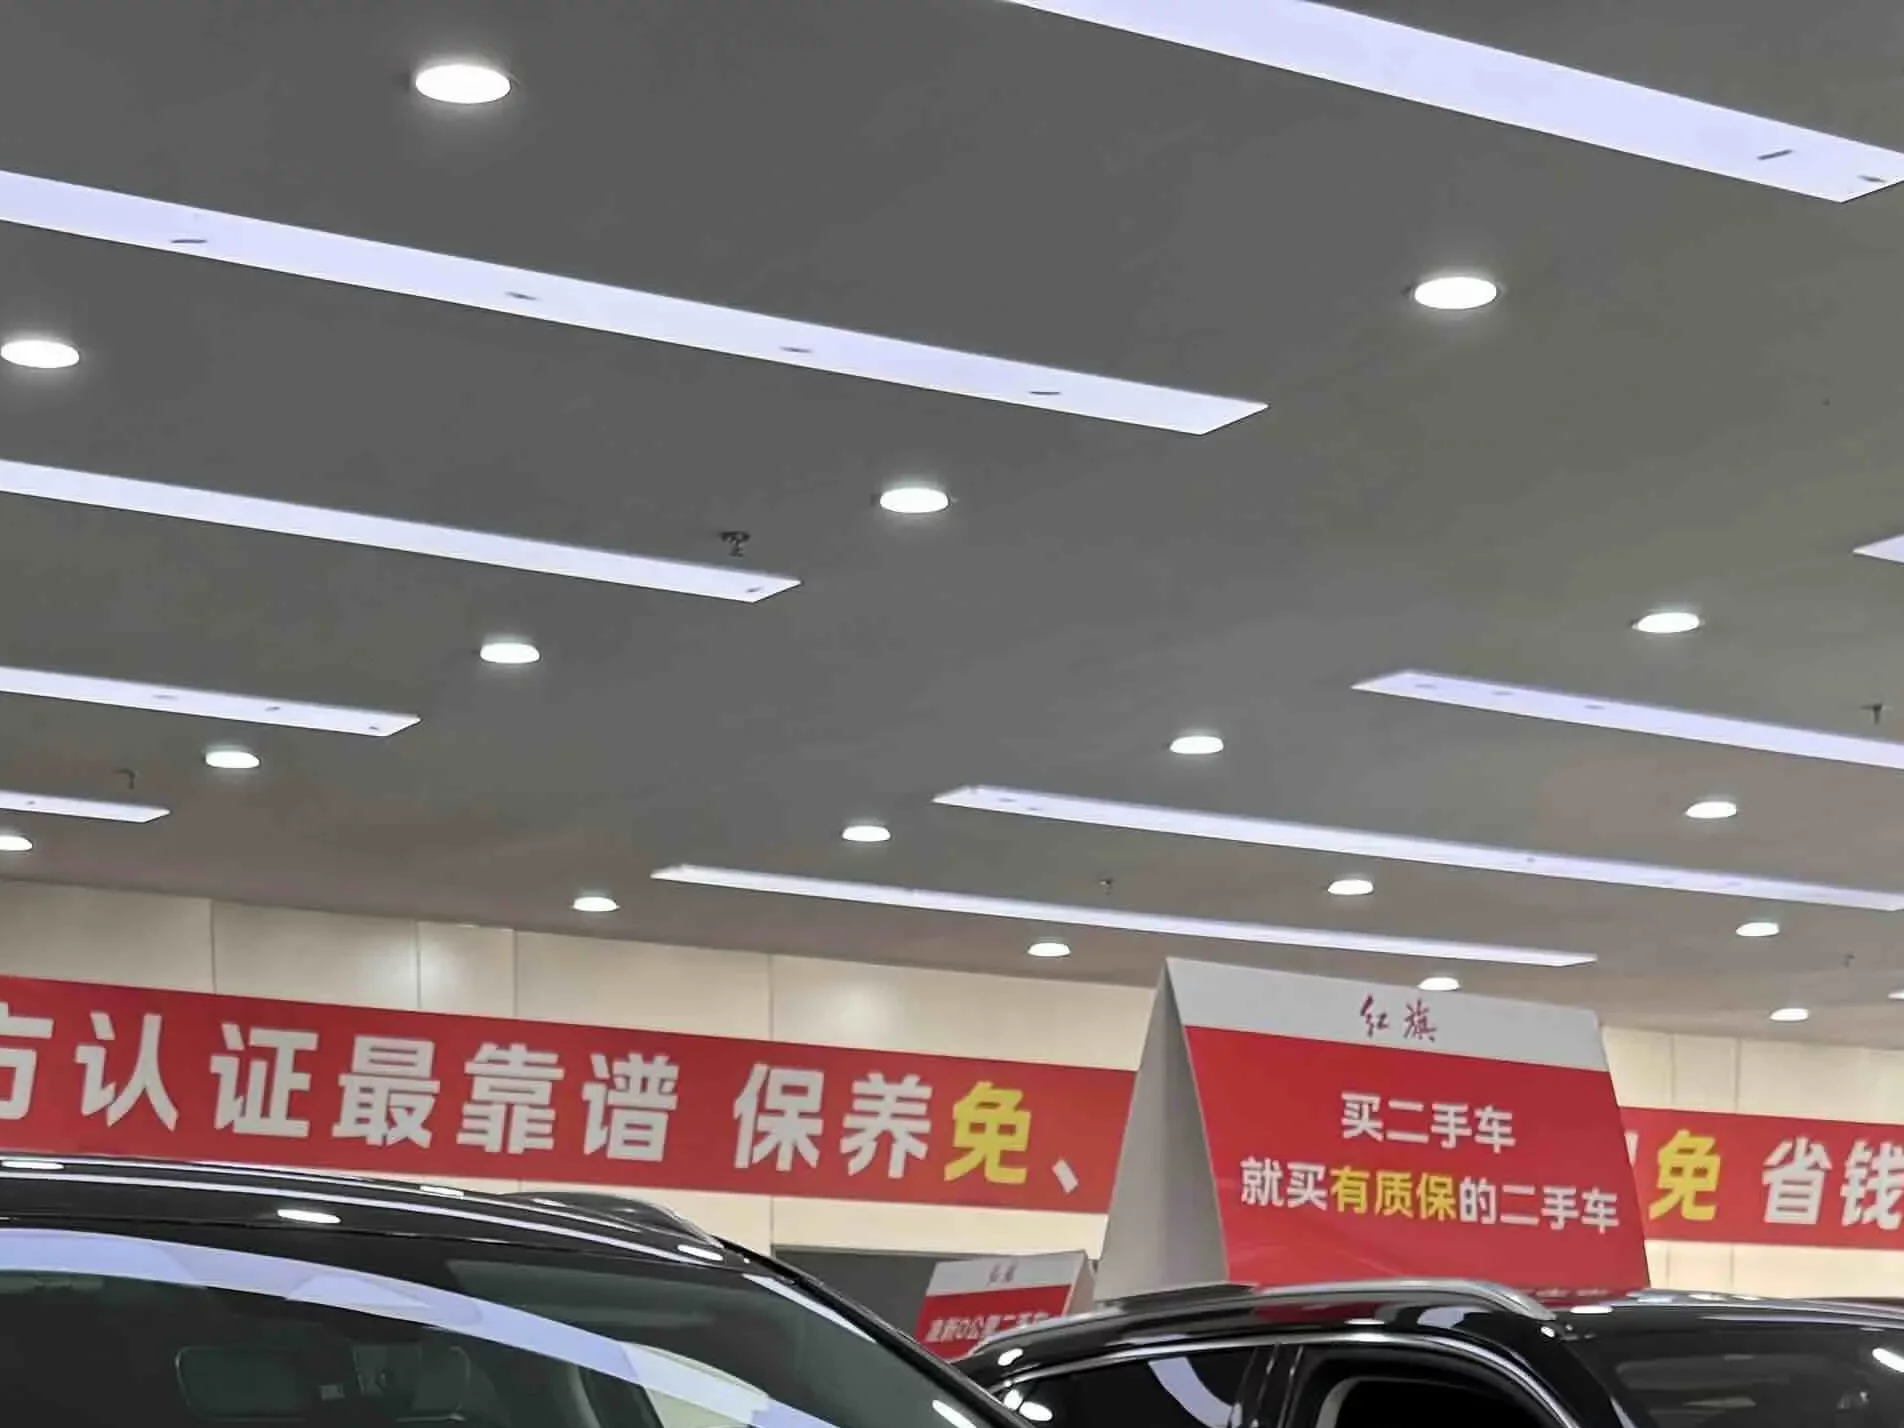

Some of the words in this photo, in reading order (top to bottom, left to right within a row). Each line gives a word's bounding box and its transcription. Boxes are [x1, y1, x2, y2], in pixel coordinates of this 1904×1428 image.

[1359, 994, 1439, 1042] 红旗
[733, 1062, 1079, 1193] 保养免、
[1341, 1091, 1516, 1153] 买二手车
[1240, 1157, 1620, 1235] 就买有质保的二手车
